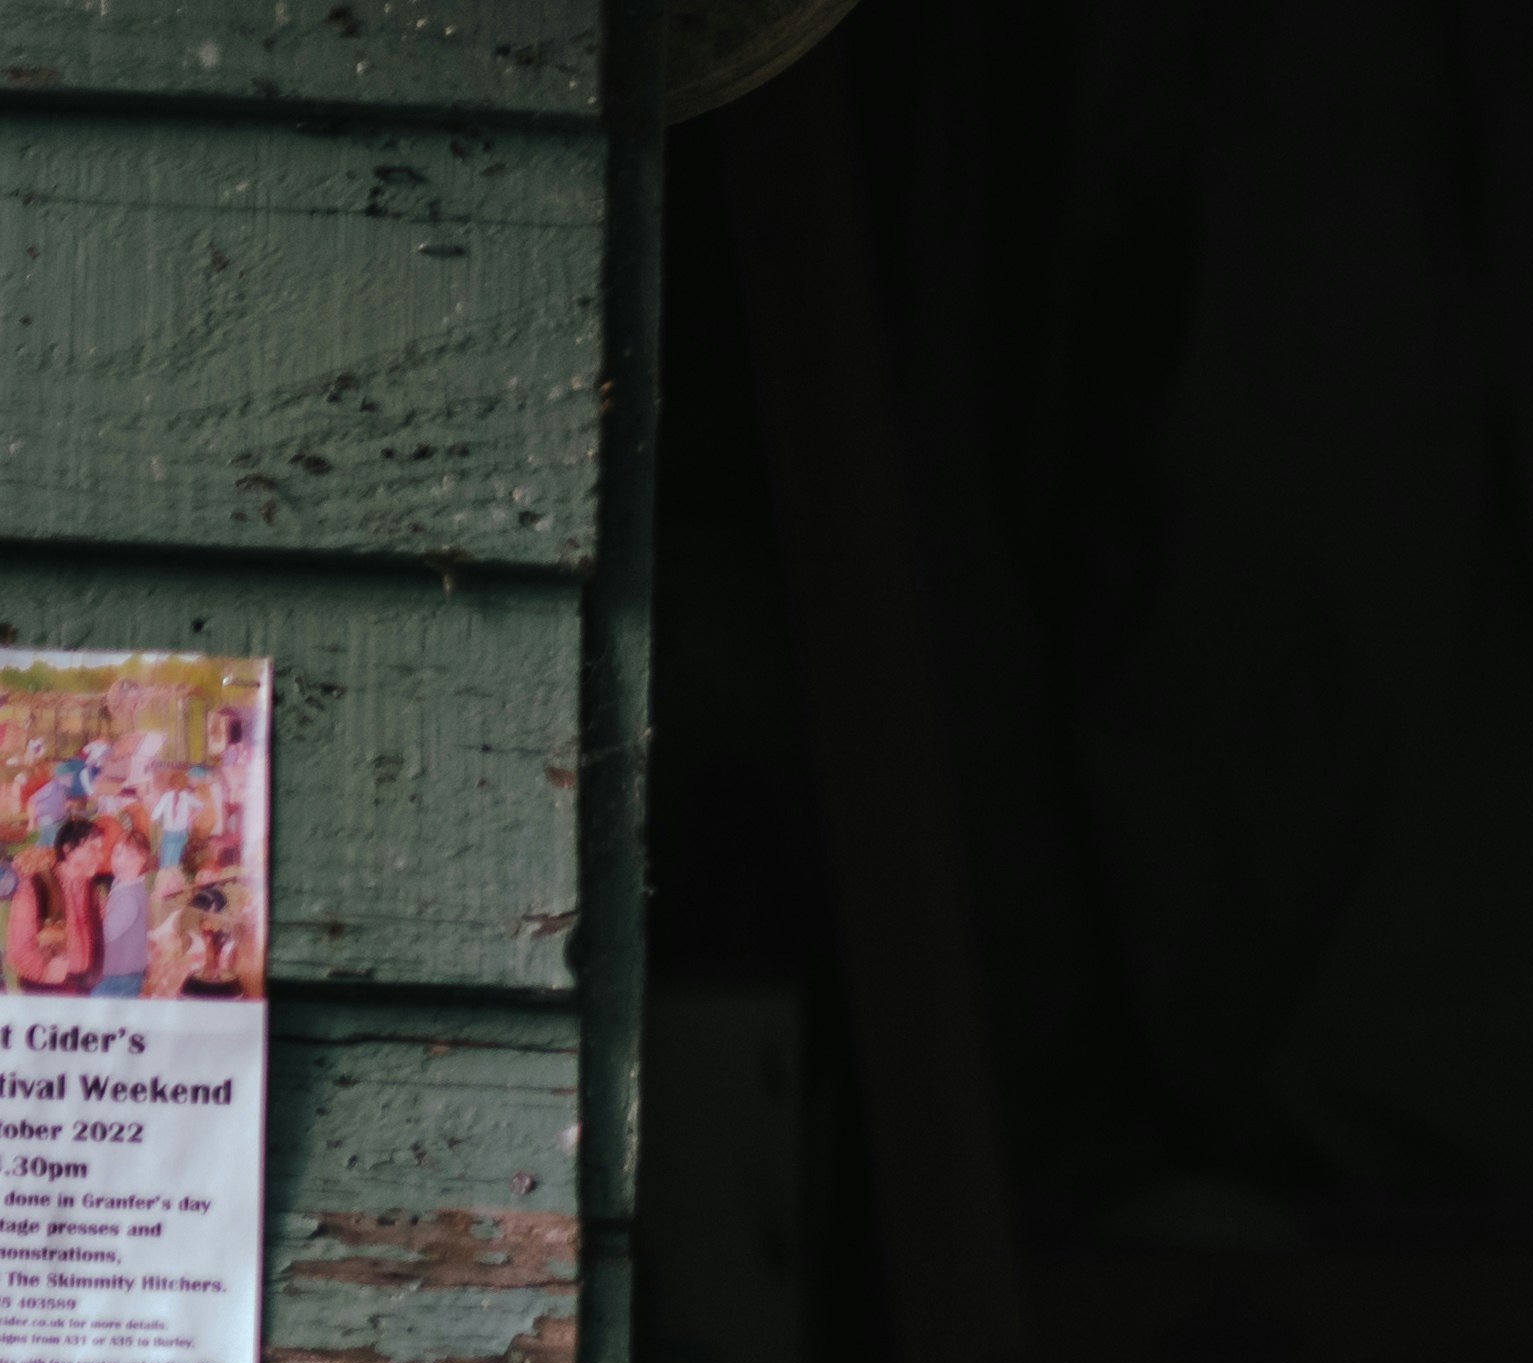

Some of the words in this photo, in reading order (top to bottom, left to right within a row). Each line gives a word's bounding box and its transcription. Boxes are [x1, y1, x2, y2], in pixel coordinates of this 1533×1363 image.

[25, 1023, 146, 1054] Cider's
[79, 1074, 232, 1105] Weekend
[72, 1120, 144, 1143] 2022
[4, 1191, 50, 1207] done
[57, 1194, 74, 1209] in
[82, 1193, 171, 1212] Granfer's
[178, 1196, 211, 1216] day
[47, 1222, 120, 1238] presses
[127, 1222, 162, 1238] and
[8, 1272, 40, 1288] The
[47, 1273, 135, 1293] Skimmity
[141, 1276, 228, 1294] Hitchers.
[69, 1318, 86, 1329] for
[90, 1319, 121, 1330] more
[31, 1334, 60, 1346] from
[92, 1337, 106, 1347] or
